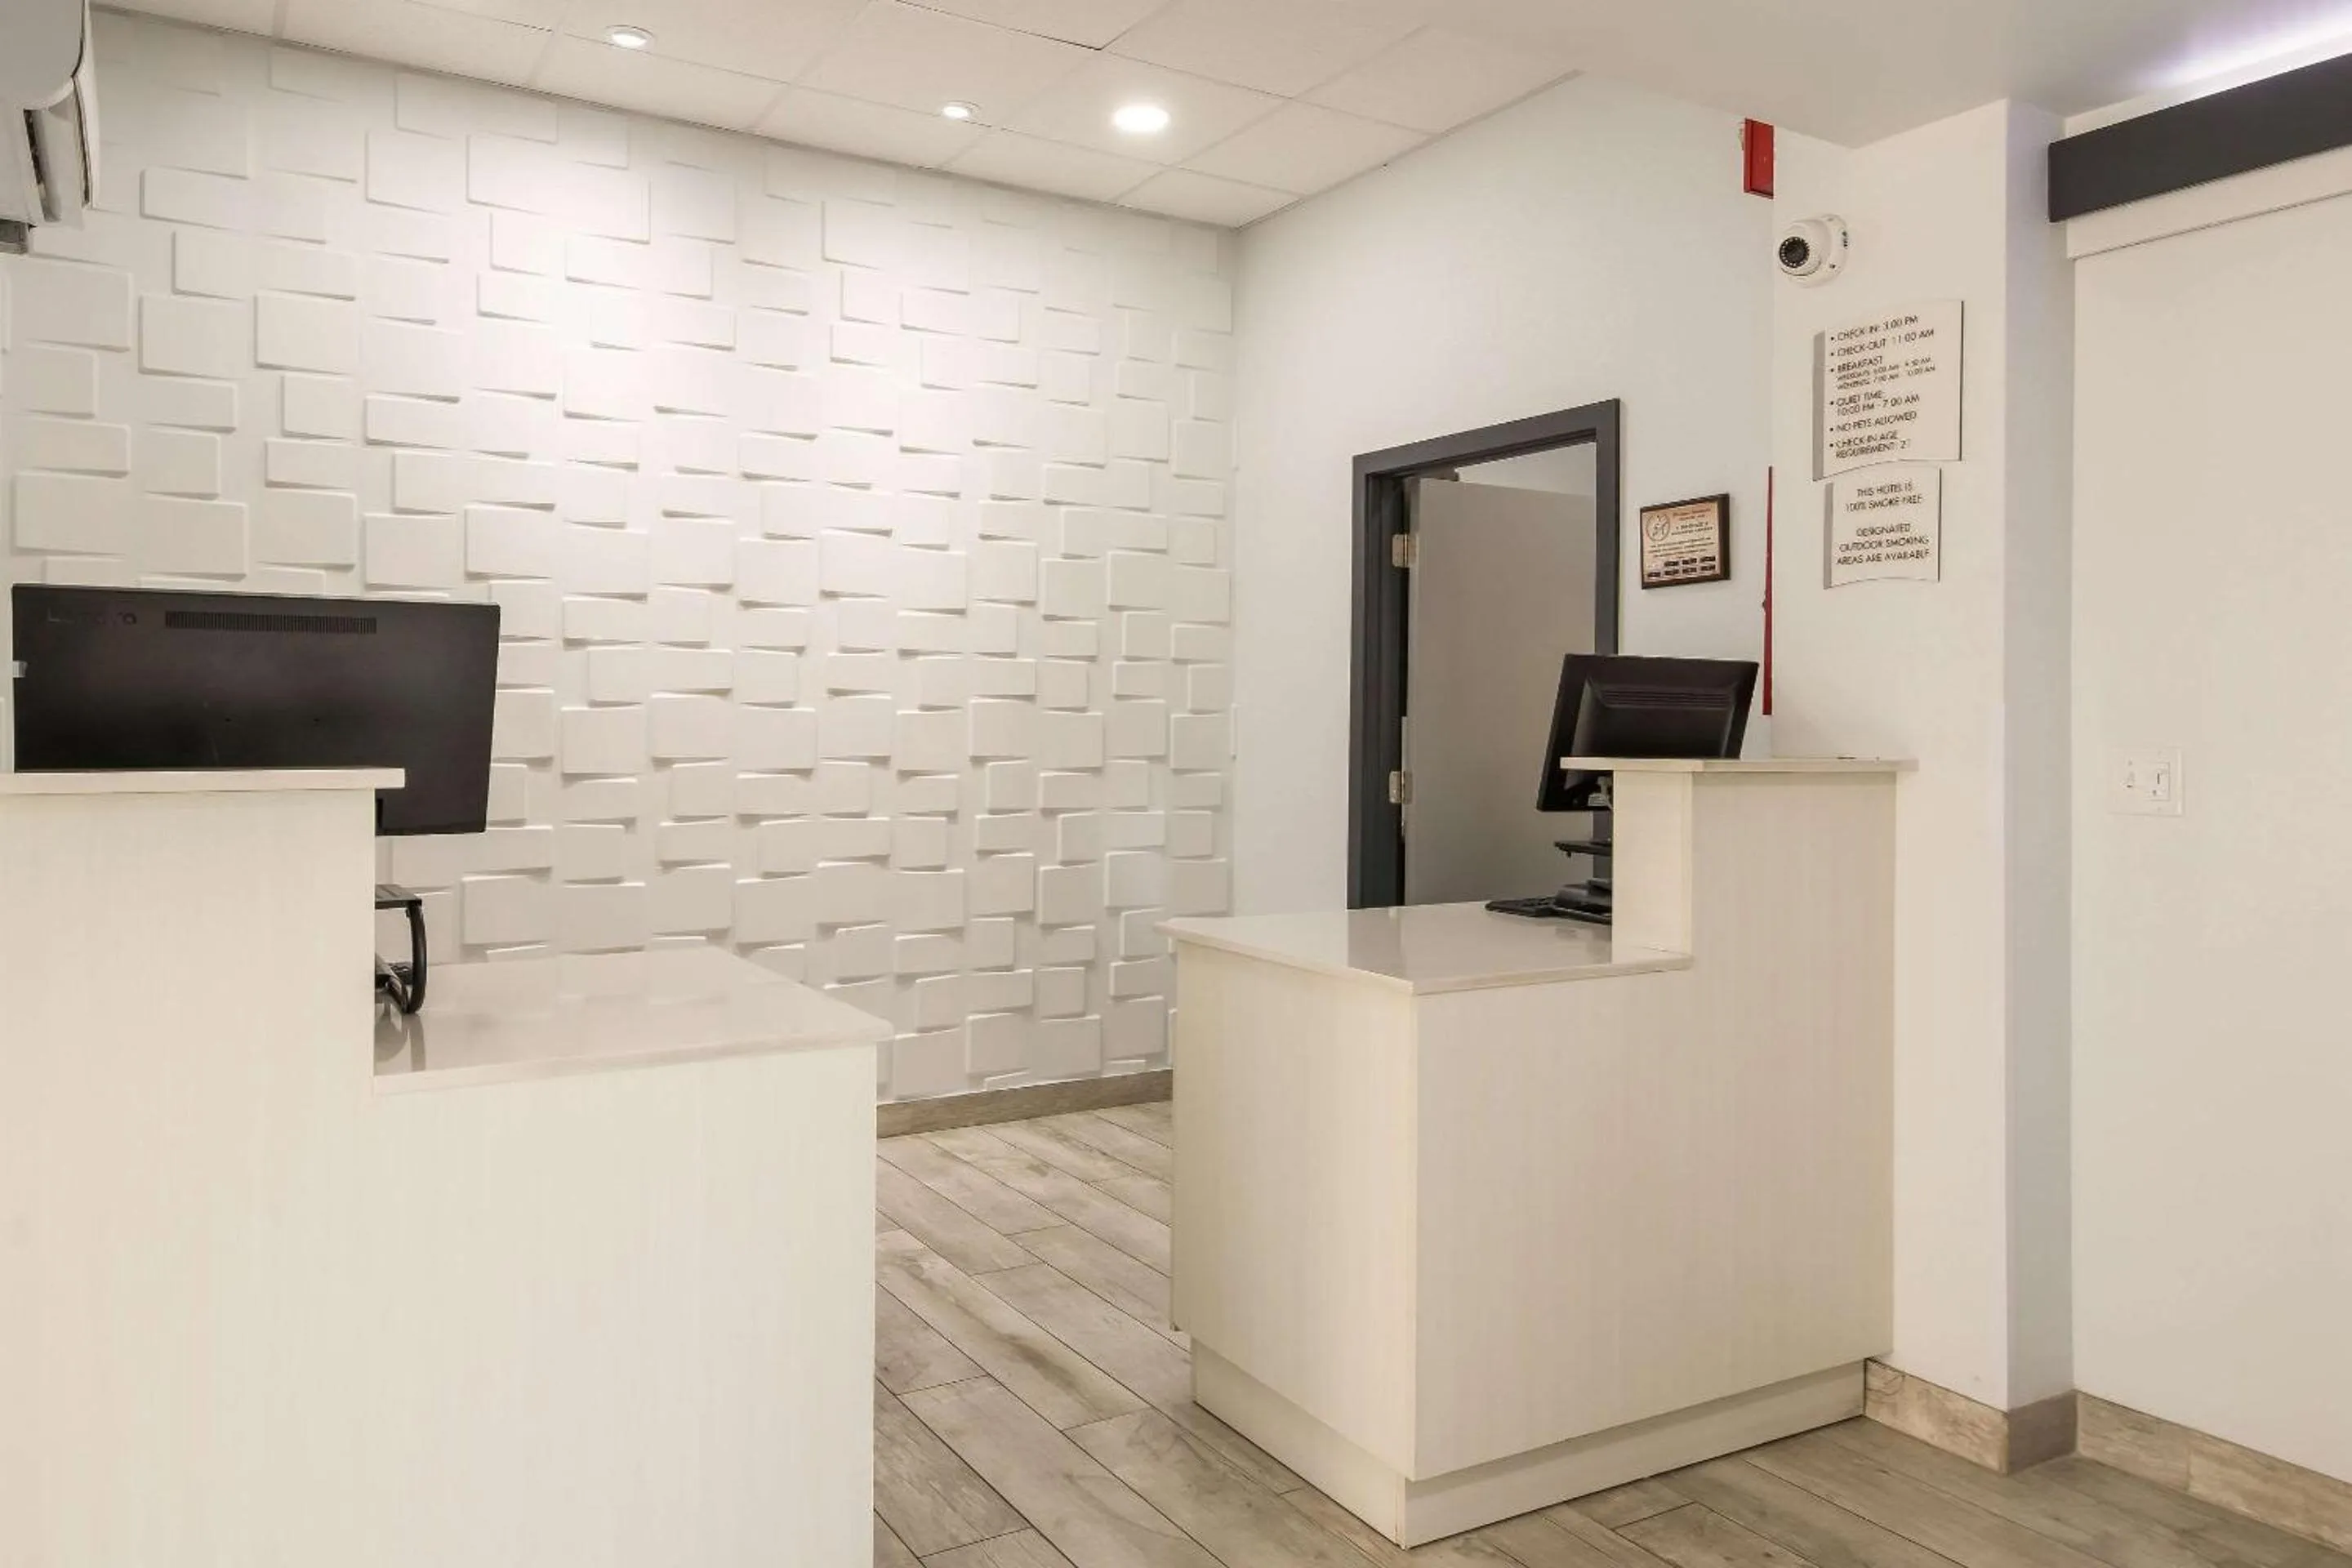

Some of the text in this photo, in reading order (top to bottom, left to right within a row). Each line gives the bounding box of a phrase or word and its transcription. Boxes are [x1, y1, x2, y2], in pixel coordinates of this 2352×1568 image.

[1904, 315, 1918, 325] PM
[1919, 328, 1934, 339] AM
[1836, 394, 1860, 407] QUIET
[1862, 402, 1874, 412] PM
[1904, 394, 1920, 403] AM
[1837, 411, 1918, 431] NO PETS ALLOWED
[1880, 430, 1898, 440] AGE
[1857, 481, 1913, 497] THIS HOTEL IS
[1846, 501, 1867, 512] 100%
[1855, 523, 1910, 537] DESIGNATED
[1839, 535, 1930, 553] OUTDOOR SMOKING
[1836, 548, 1930, 565] AREAS ARE AVAILABLE
